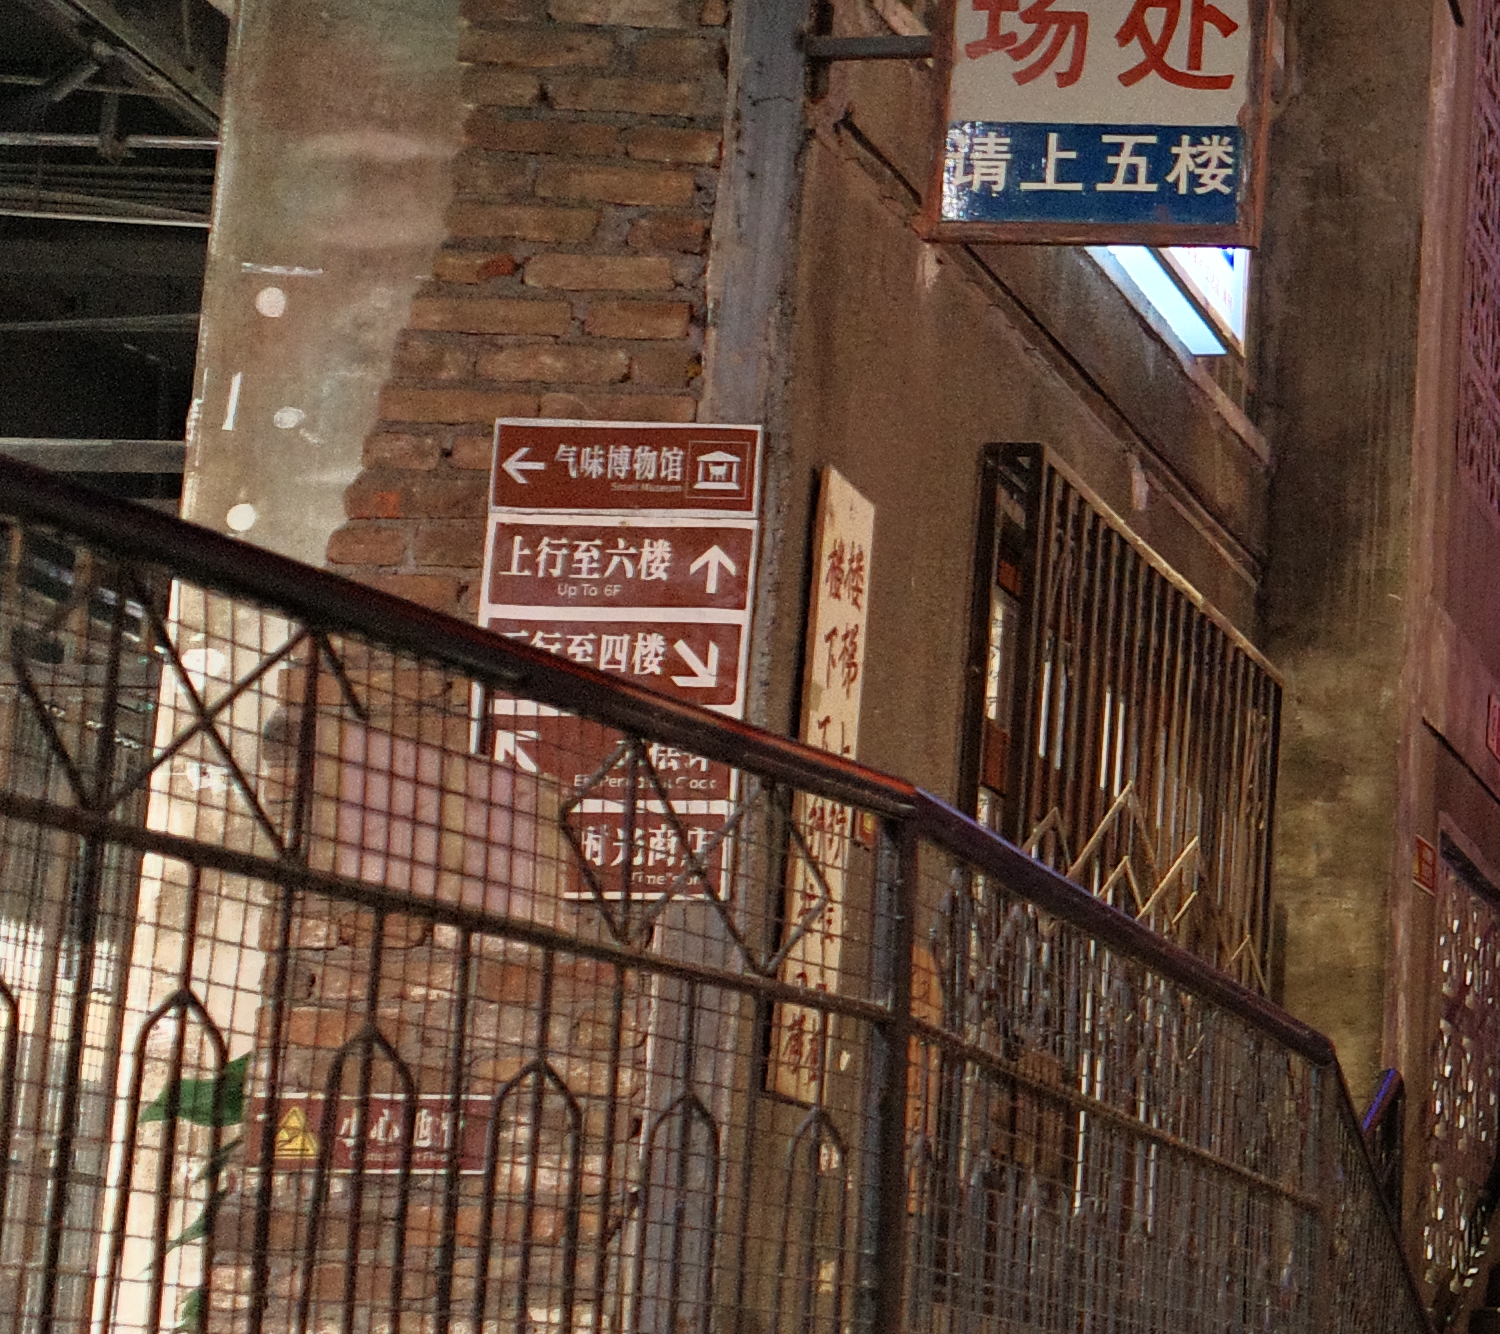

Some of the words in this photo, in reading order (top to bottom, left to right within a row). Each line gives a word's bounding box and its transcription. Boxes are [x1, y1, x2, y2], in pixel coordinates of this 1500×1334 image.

[951, 132, 1236, 197] 请上五楼
[554, 444, 684, 481] 气味博物馆
[499, 535, 673, 583] 上行至六楼
[558, 583, 579, 599] Up
[582, 583, 598, 597] To
[603, 583, 623, 598] 6F
[500, 631, 668, 676] 行至四楼
